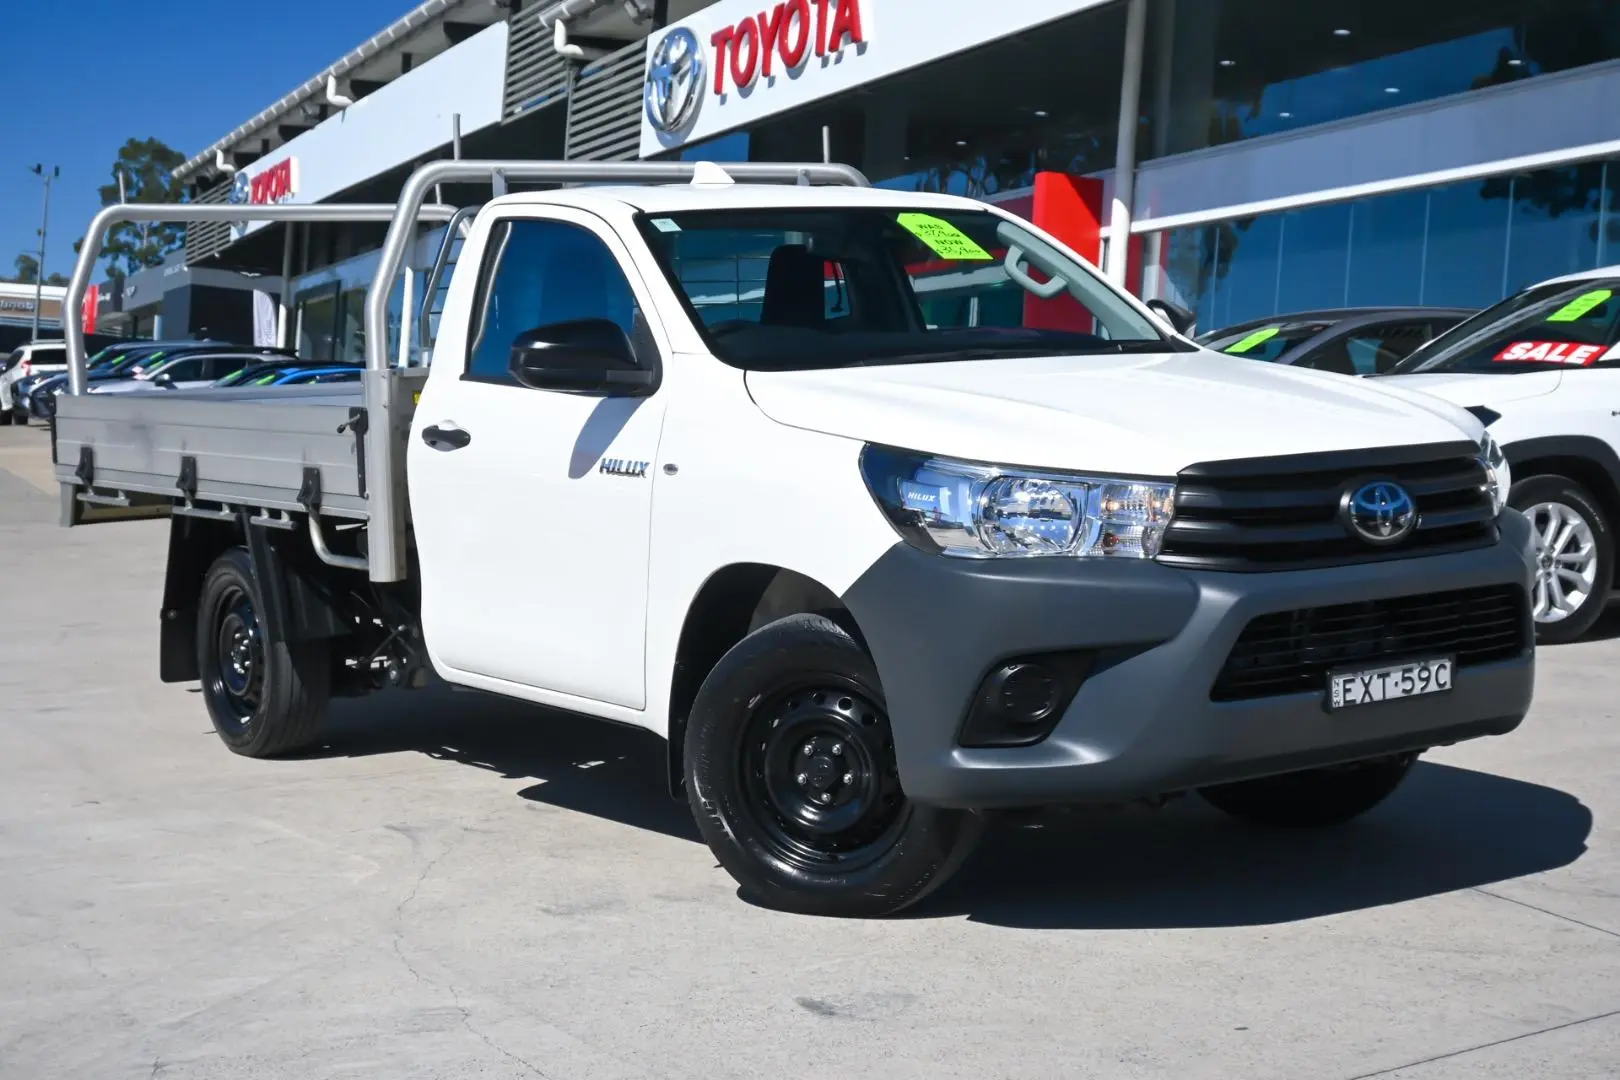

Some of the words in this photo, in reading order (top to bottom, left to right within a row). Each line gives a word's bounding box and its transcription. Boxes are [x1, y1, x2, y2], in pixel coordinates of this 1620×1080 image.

[711, 0, 863, 95] TOYOTA
[250, 157, 291, 205] TOYOTA
[1502, 342, 1601, 364] SALE
[599, 458, 650, 478] HILUX
[907, 491, 937, 502] HILUX
